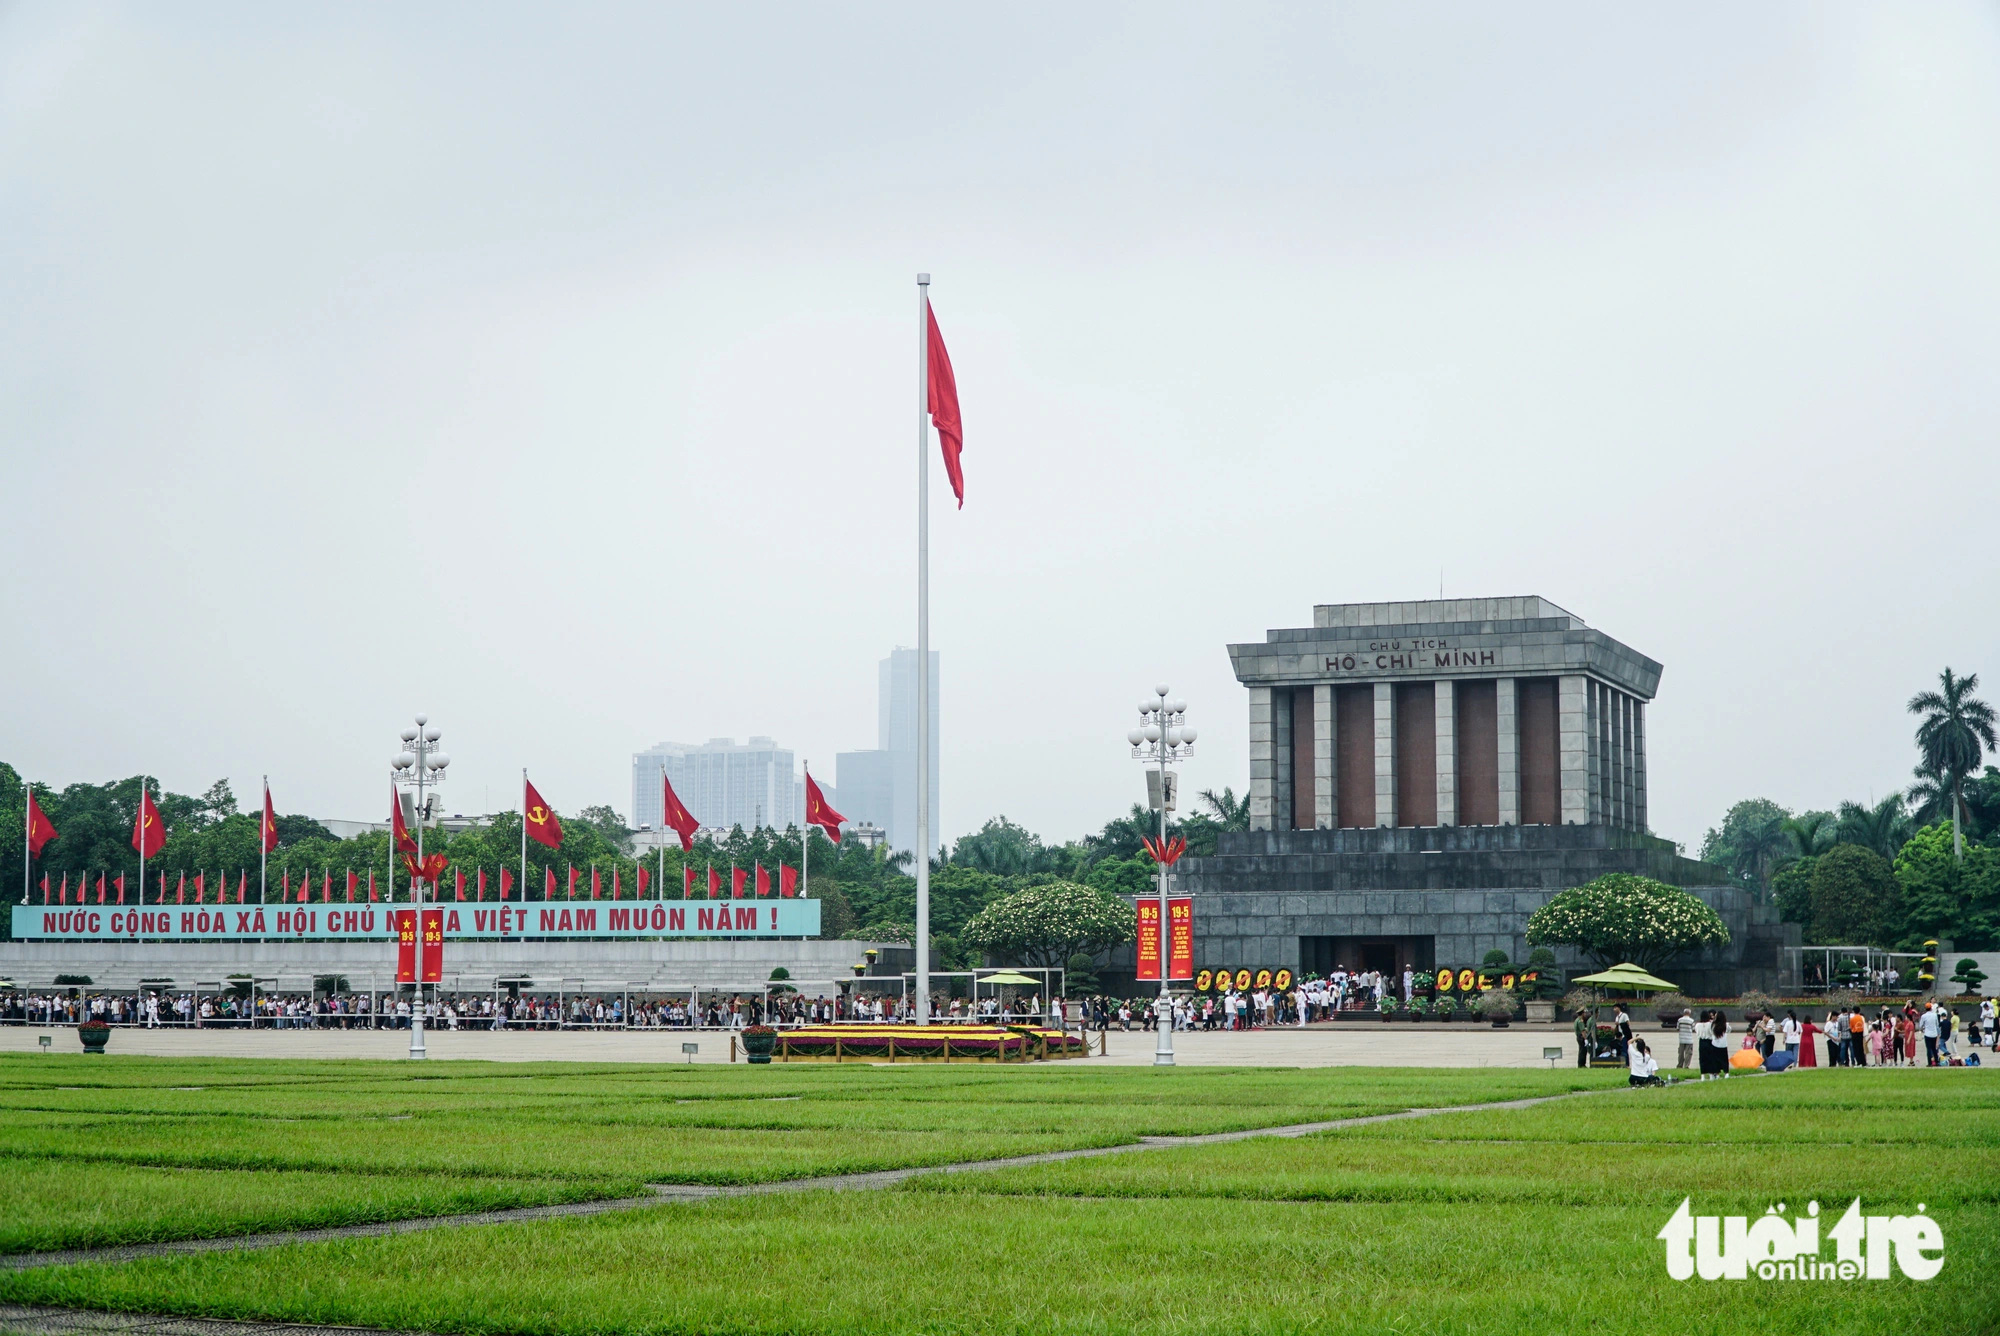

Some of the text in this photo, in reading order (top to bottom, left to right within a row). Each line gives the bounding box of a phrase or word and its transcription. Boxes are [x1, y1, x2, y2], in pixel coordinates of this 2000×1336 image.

[44, 908, 100, 933] NƯỚC
[111, 908, 170, 937] CỘNG
[181, 908, 226, 933] HÒA
[236, 907, 267, 933] XÃ
[277, 907, 316, 936] HỘI
[328, 904, 374, 932] CHỦ
[474, 905, 527, 935] VIỆT
[540, 909, 596, 931] NAM
[609, 904, 685, 931] MUÔN
[698, 903, 757, 931] NĂM
